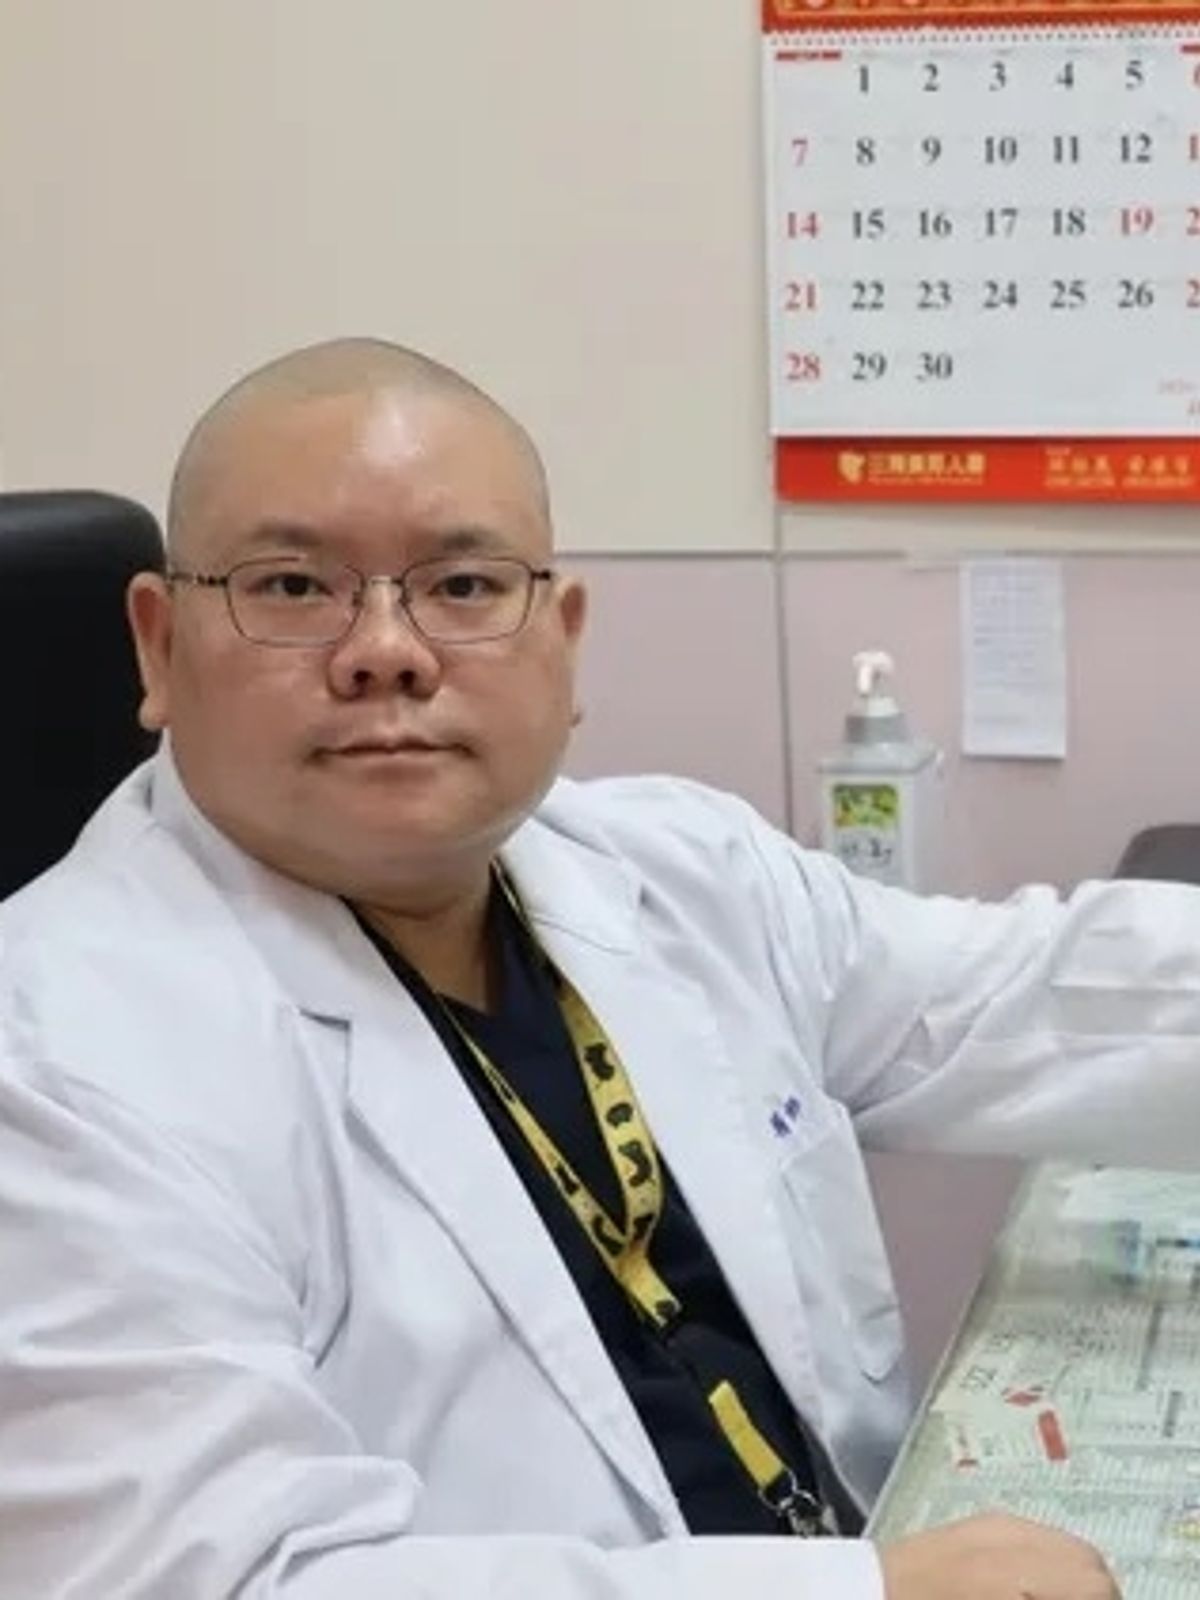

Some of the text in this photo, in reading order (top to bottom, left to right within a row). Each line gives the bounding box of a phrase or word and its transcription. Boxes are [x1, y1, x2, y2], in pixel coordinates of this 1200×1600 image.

[858, 64, 870, 94] 1
[921, 62, 940, 93] 2
[988, 60, 1007, 93] 3
[1055, 61, 1076, 91] 4
[1124, 59, 1144, 91] 5
[790, 137, 810, 167] 7
[855, 137, 877, 166] 8
[921, 136, 943, 164] 9
[984, 135, 1019, 165] 10
[1052, 135, 1081, 165] 11
[1120, 132, 1154, 164] 12
[786, 211, 820, 240] 14
[852, 207, 886, 240] 15
[918, 208, 953, 238] 16
[984, 207, 1020, 238] 17
[1052, 208, 1087, 237] 18
[1120, 206, 1155, 237] 19
[785, 281, 818, 311] 21
[850, 279, 886, 311] 22
[916, 279, 953, 311] 23
[982, 279, 1019, 310] 24
[1049, 279, 1088, 310] 25
[1117, 278, 1155, 310] 26
[786, 351, 954, 382] 28 29 30
